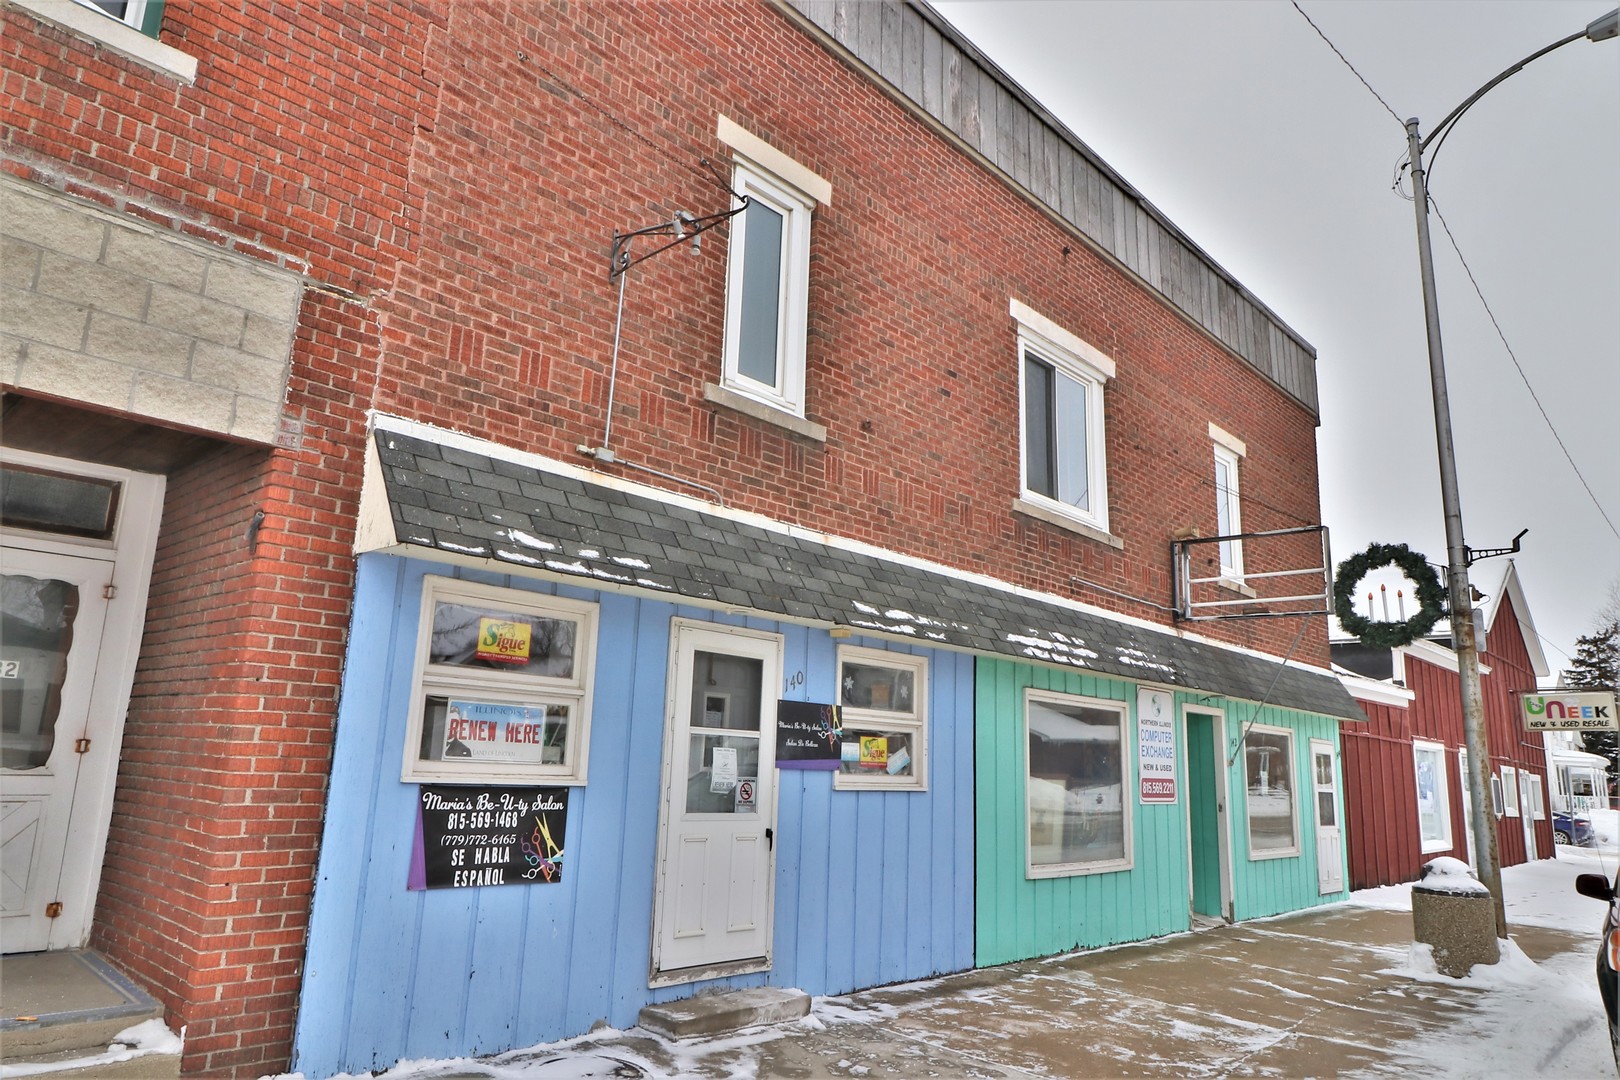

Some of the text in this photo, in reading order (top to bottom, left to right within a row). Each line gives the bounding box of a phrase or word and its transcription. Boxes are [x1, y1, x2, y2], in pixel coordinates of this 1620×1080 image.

[483, 624, 525, 653] Sigue
[0, 662, 17, 677] 2
[785, 670, 804, 693] 140
[475, 705, 522, 716] ILLINOIS
[448, 718, 541, 744] RENEW HERE
[1141, 729, 1172, 743] COMPUTER
[863, 738, 885, 761] Sigue
[1142, 745, 1173, 759] EXCHANGE
[1155, 763, 1160, 772] &
[422, 791, 565, 817] Maria's Be-U-ty Salon
[447, 811, 518, 830] 815-569-1468
[440, 833, 517, 847] (779)772-6165
[450, 846, 510, 866] SE HABLA
[453, 867, 505, 887] ESPAÑOL
